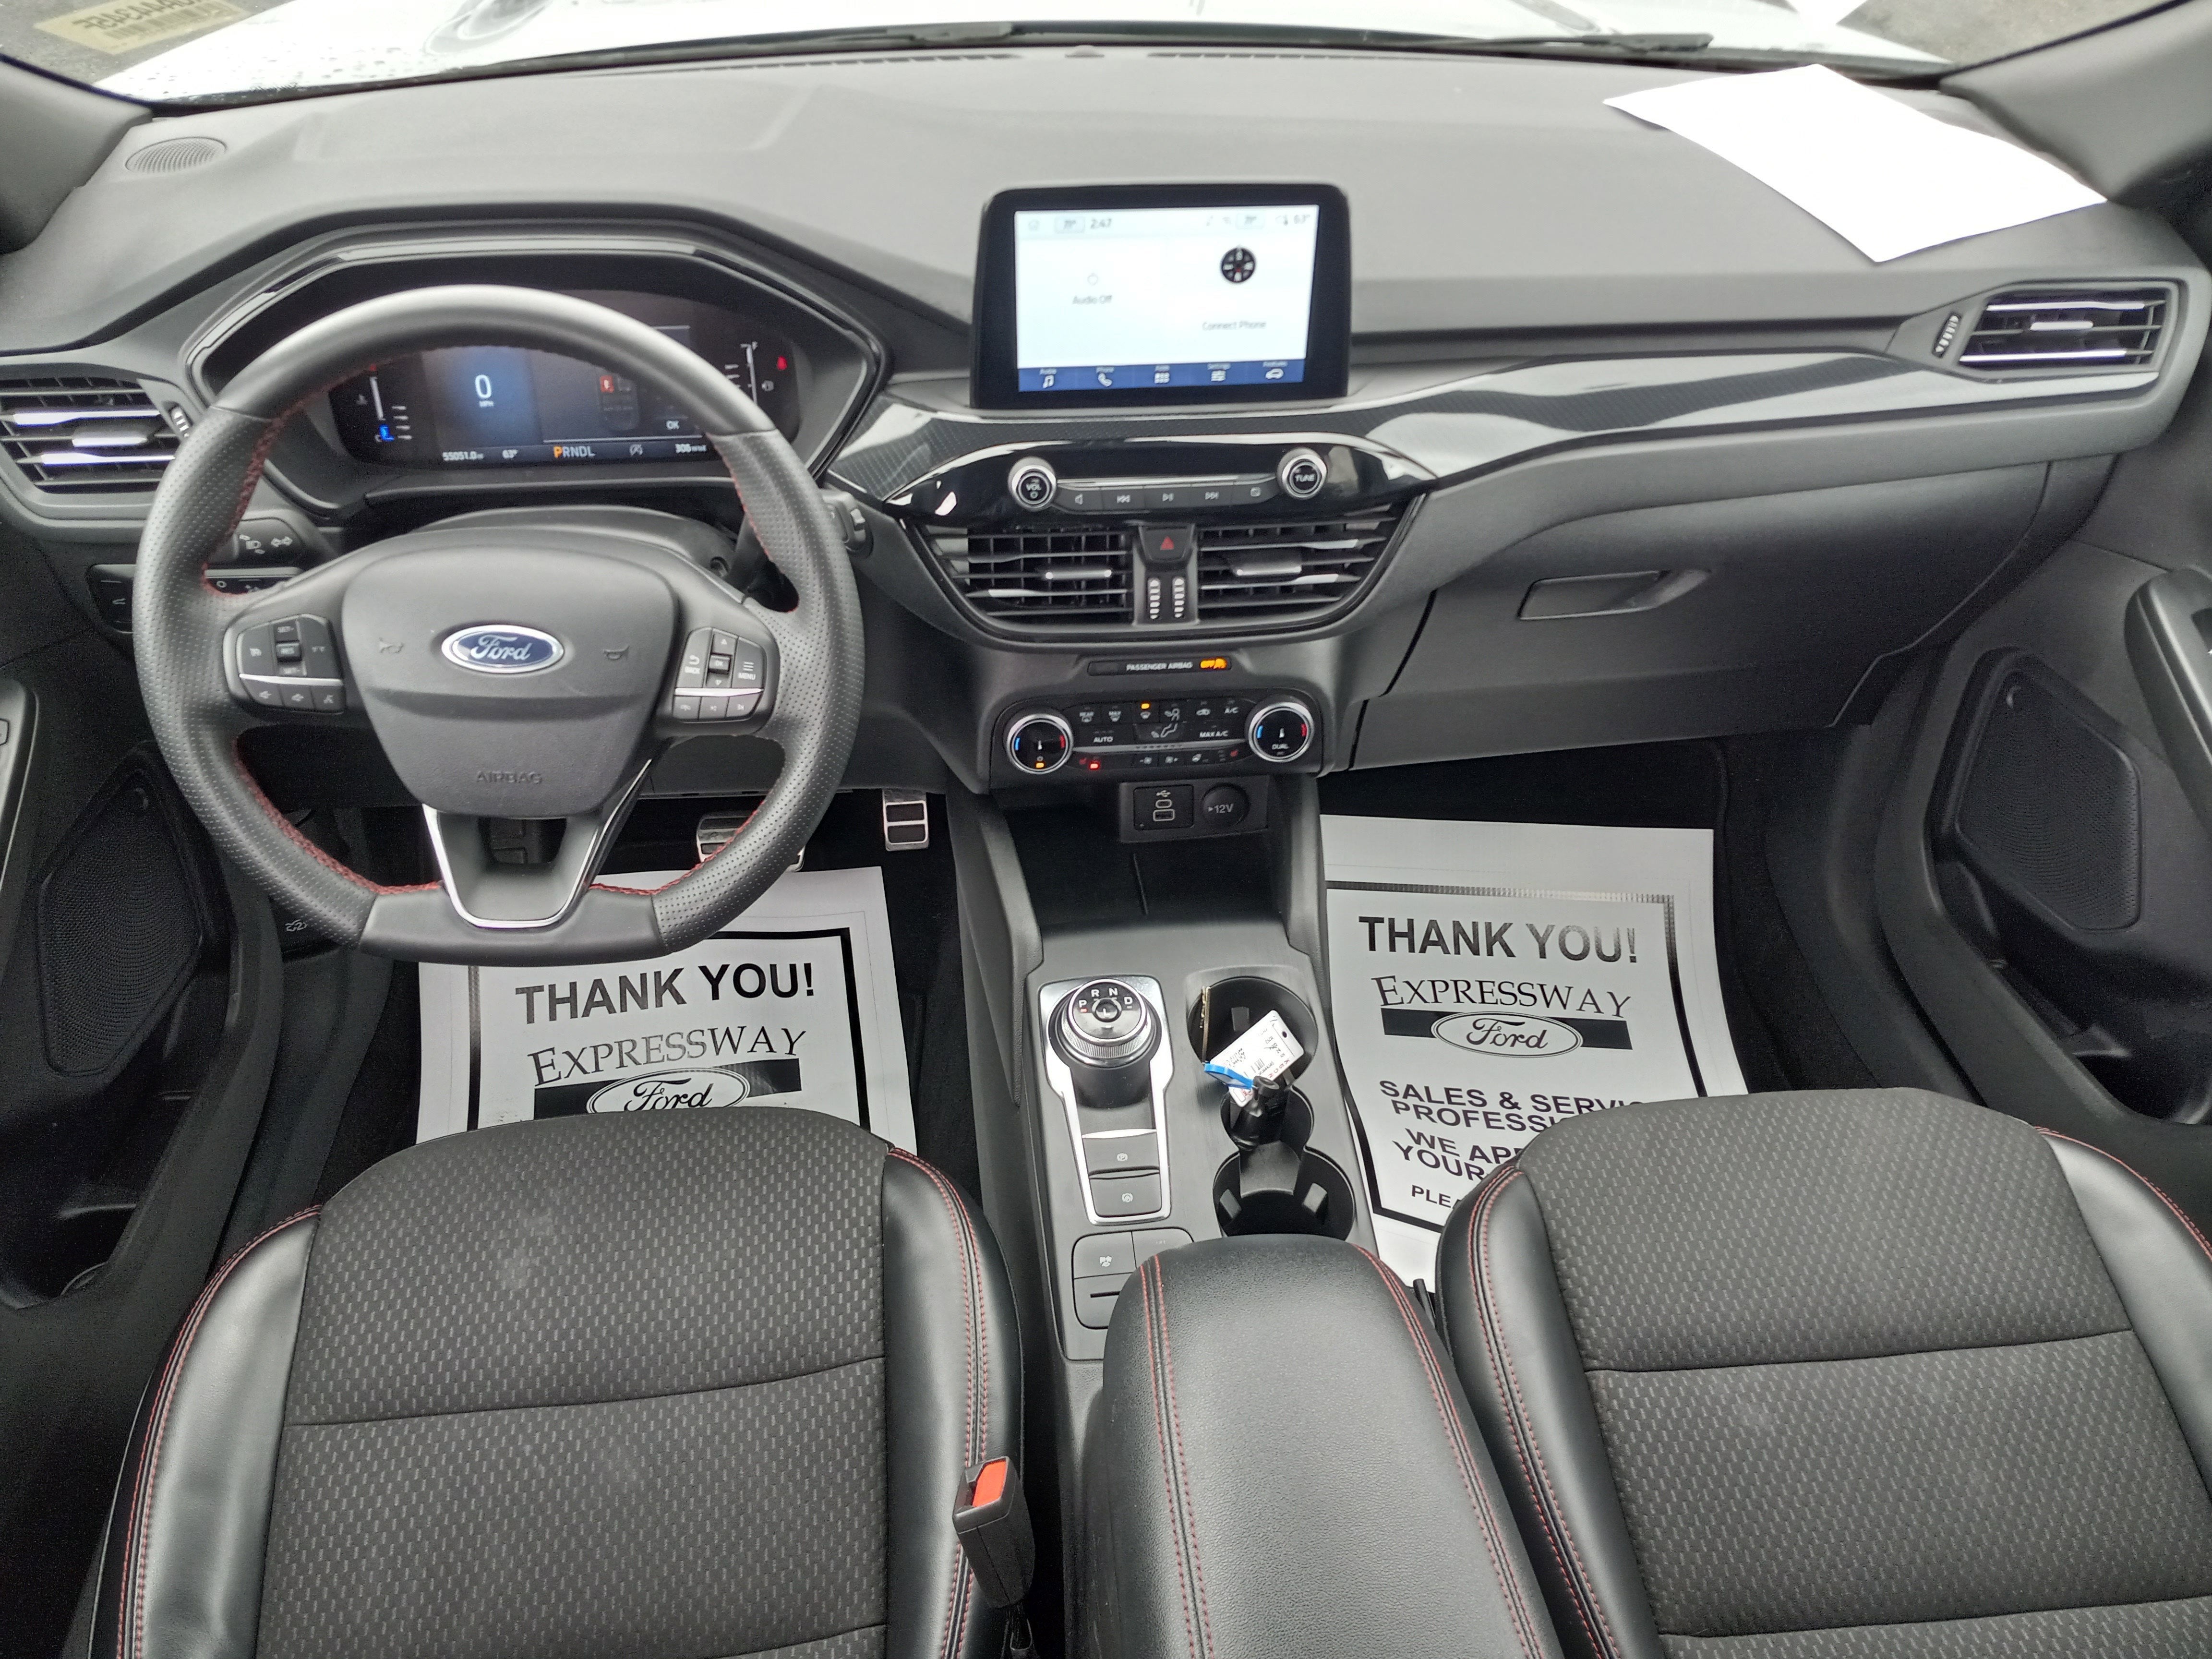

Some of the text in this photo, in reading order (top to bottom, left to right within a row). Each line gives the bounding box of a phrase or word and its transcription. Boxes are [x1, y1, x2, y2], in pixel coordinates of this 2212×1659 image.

[1238, 320, 1266, 329] Phone
[475, 374, 492, 399] 0
[666, 420, 680, 430] OK
[1295, 473, 1315, 482] TUNE
[470, 635, 532, 661] Ford
[685, 666, 701, 674] BACK
[1126, 662, 1167, 671] PASSENGER
[1168, 661, 1193, 670] AIRBAG
[476, 771, 542, 784] AIRBAG
[1214, 804, 1234, 813] 12V
[1358, 916, 1637, 963] THANK YOU!
[515, 962, 814, 1024] THANK YOU!
[1091, 989, 1100, 997] R
[1108, 987, 1118, 996] N
[1124, 997, 1133, 1005] D
[1371, 975, 1631, 1019] EXPRESSWAY
[1103, 1008, 1110, 1016] L
[1466, 1018, 1548, 1049] Ford
[527, 1025, 806, 1087] EXPRESSWAY
[624, 1078, 714, 1111] Ford
[1379, 1080, 1644, 1114] SALES & SERV
[1391, 1099, 1567, 1133] PROFESS
[1405, 1128, 1460, 1157] WE
[1392, 1140, 1486, 1181] YOUR
[1412, 1184, 1461, 1210] PLE
